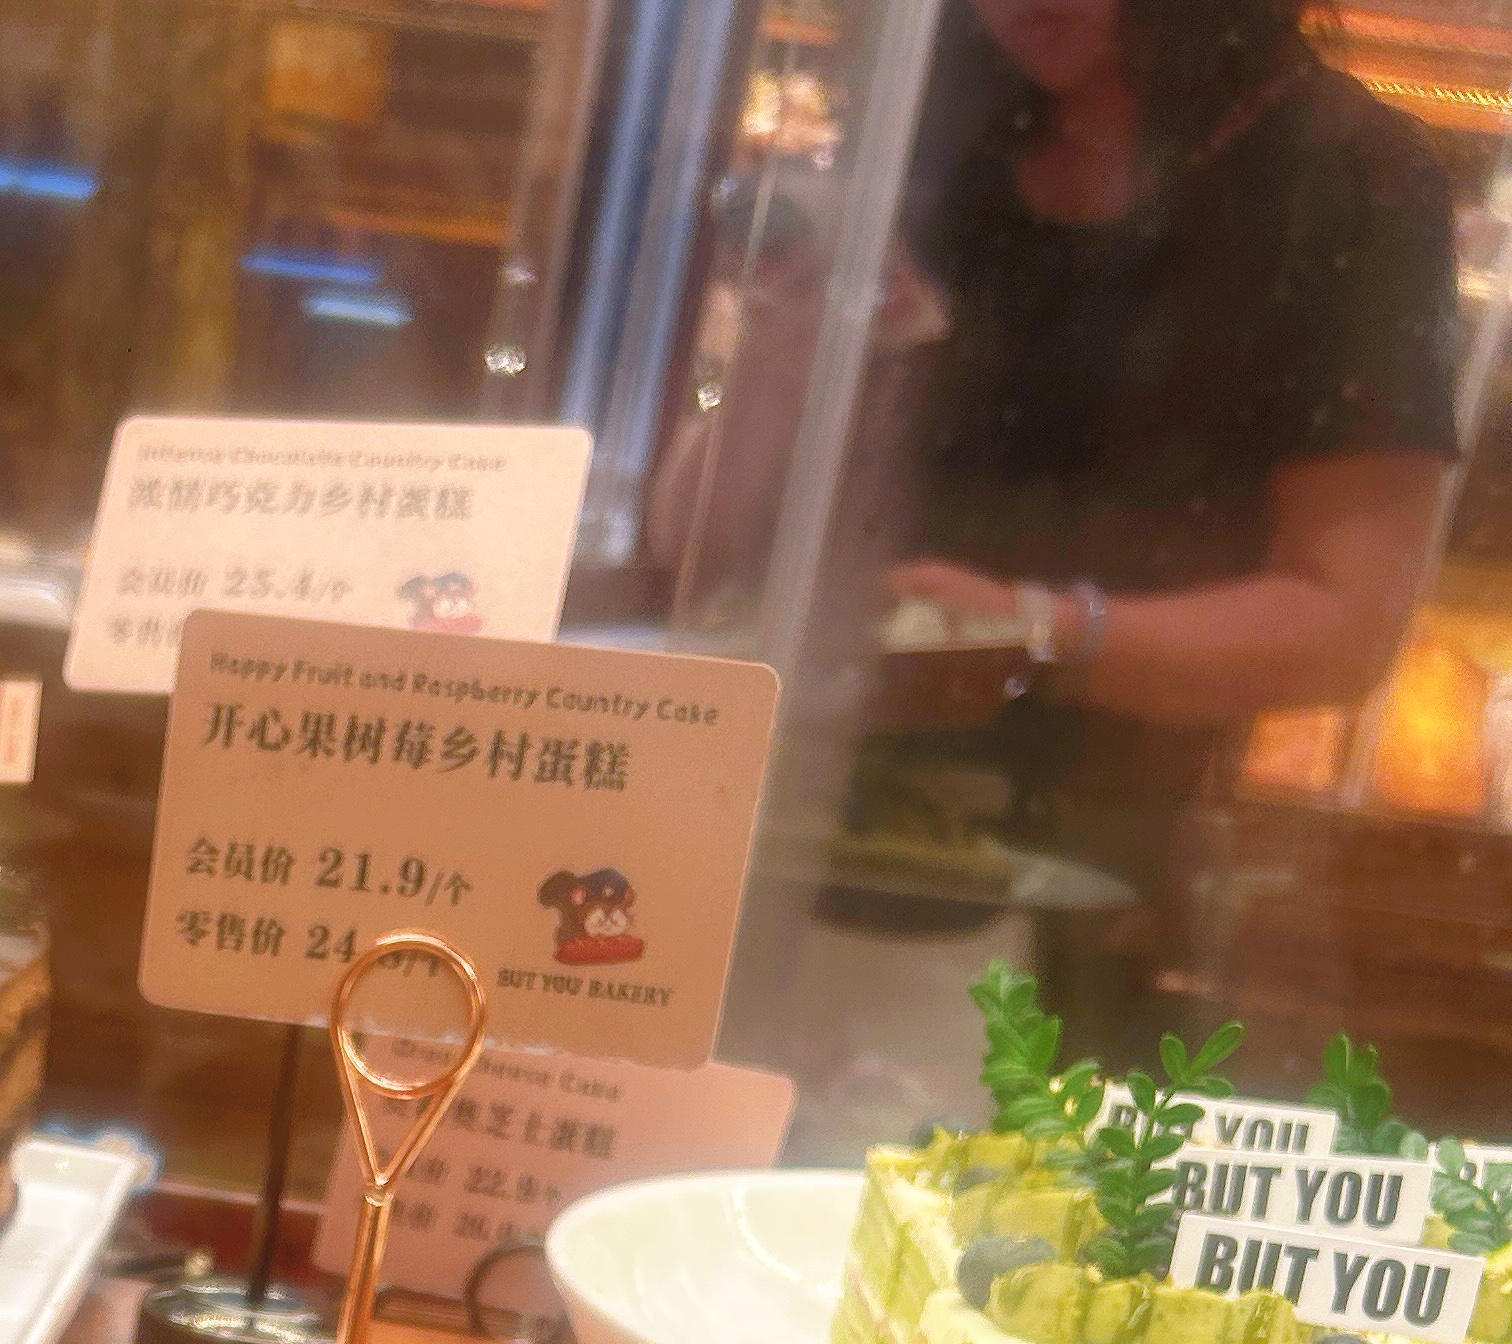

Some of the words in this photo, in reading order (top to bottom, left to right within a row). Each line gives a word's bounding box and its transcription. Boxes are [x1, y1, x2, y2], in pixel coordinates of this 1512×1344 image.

[210, 652, 288, 683] Happy
[292, 659, 354, 688] Fruit
[359, 669, 405, 692] and
[412, 673, 539, 710] Raspberry
[547, 687, 650, 721] Country
[656, 698, 720, 726] Cake
[203, 701, 631, 792] 开心果树莓乡村蛋糕
[186, 837, 294, 885] 会员价
[176, 910, 285, 957] 零售价
[497, 967, 536, 990] BUT
[541, 974, 582, 995] YOU
[587, 979, 672, 1006] BAKERY
[1173, 1160, 1281, 1220] BUT
[1295, 1168, 1404, 1229] YOU
[1195, 1233, 1319, 1304] BUT
[1331, 1251, 1451, 1327] YOU
